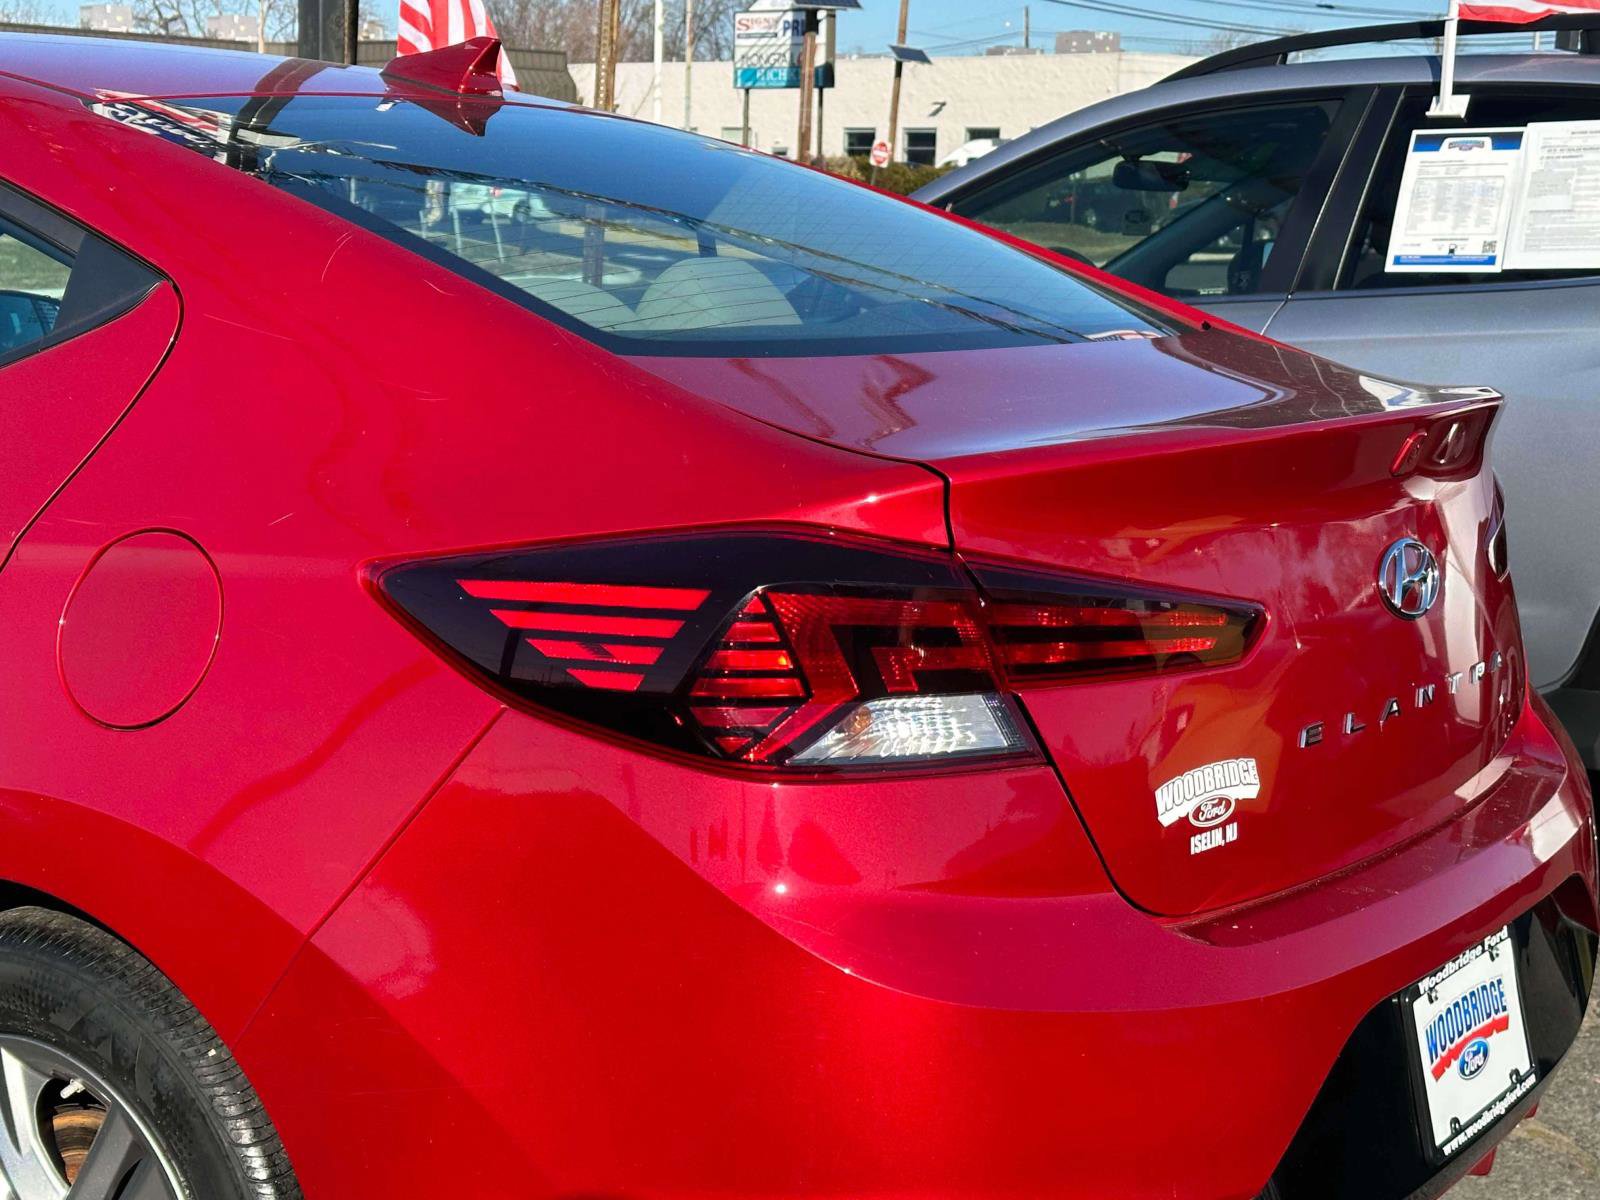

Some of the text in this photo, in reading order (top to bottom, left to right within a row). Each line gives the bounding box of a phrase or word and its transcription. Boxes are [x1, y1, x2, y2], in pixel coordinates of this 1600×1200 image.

[783, 19, 806, 37] PRI
[1297, 651, 1503, 749] ELANTRA
[1155, 758, 1259, 817] WOODBRIDGE
[1198, 798, 1226, 822] Ford
[1190, 822, 1238, 856] ISELIN, NJ
[1418, 925, 1508, 996] Woodbridge Ford
[1424, 977, 1508, 1065] WOODBRIDGE
[1464, 1045, 1484, 1075] Ford
[1442, 1075, 1537, 1157] www.woodbridgeford.com
